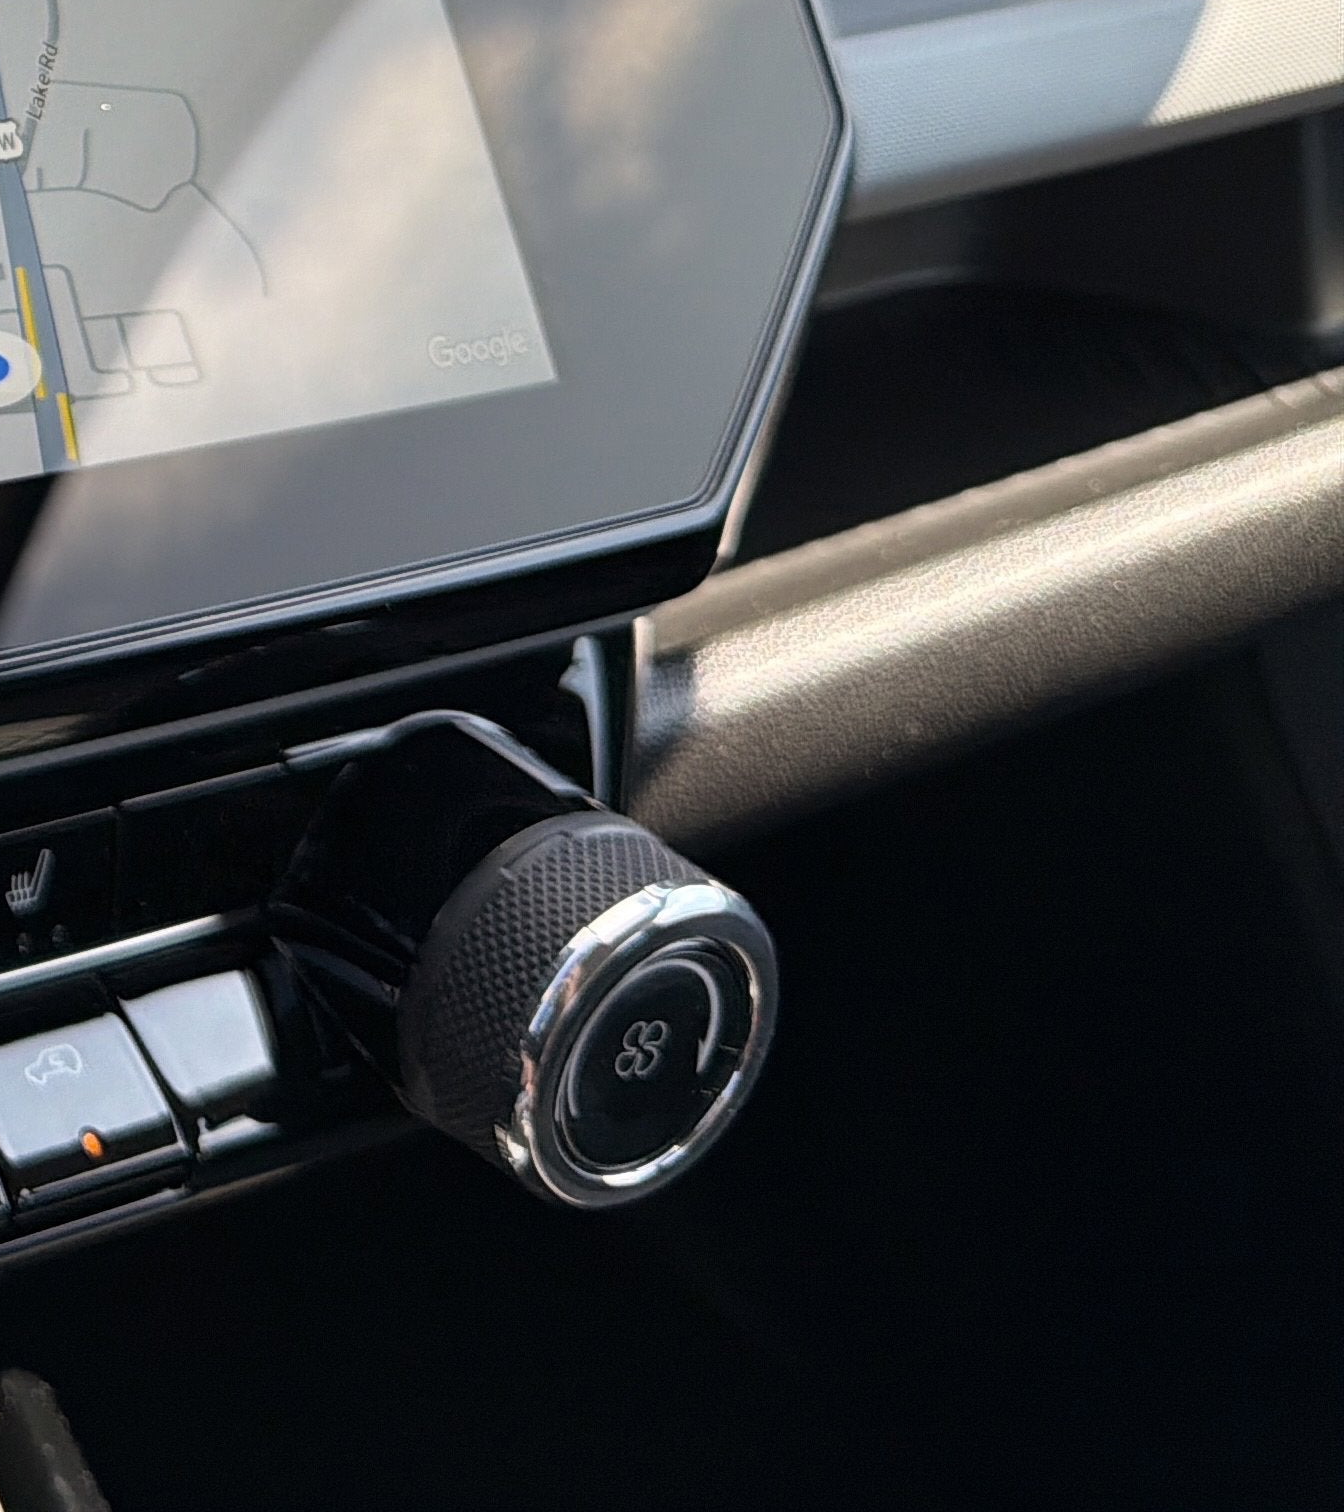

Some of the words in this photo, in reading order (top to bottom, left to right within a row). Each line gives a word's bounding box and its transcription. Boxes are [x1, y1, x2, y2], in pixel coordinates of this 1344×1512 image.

[38, 41, 60, 70] Rd
[28, 69, 52, 122] Lake
[427, 325, 529, 370] Google
